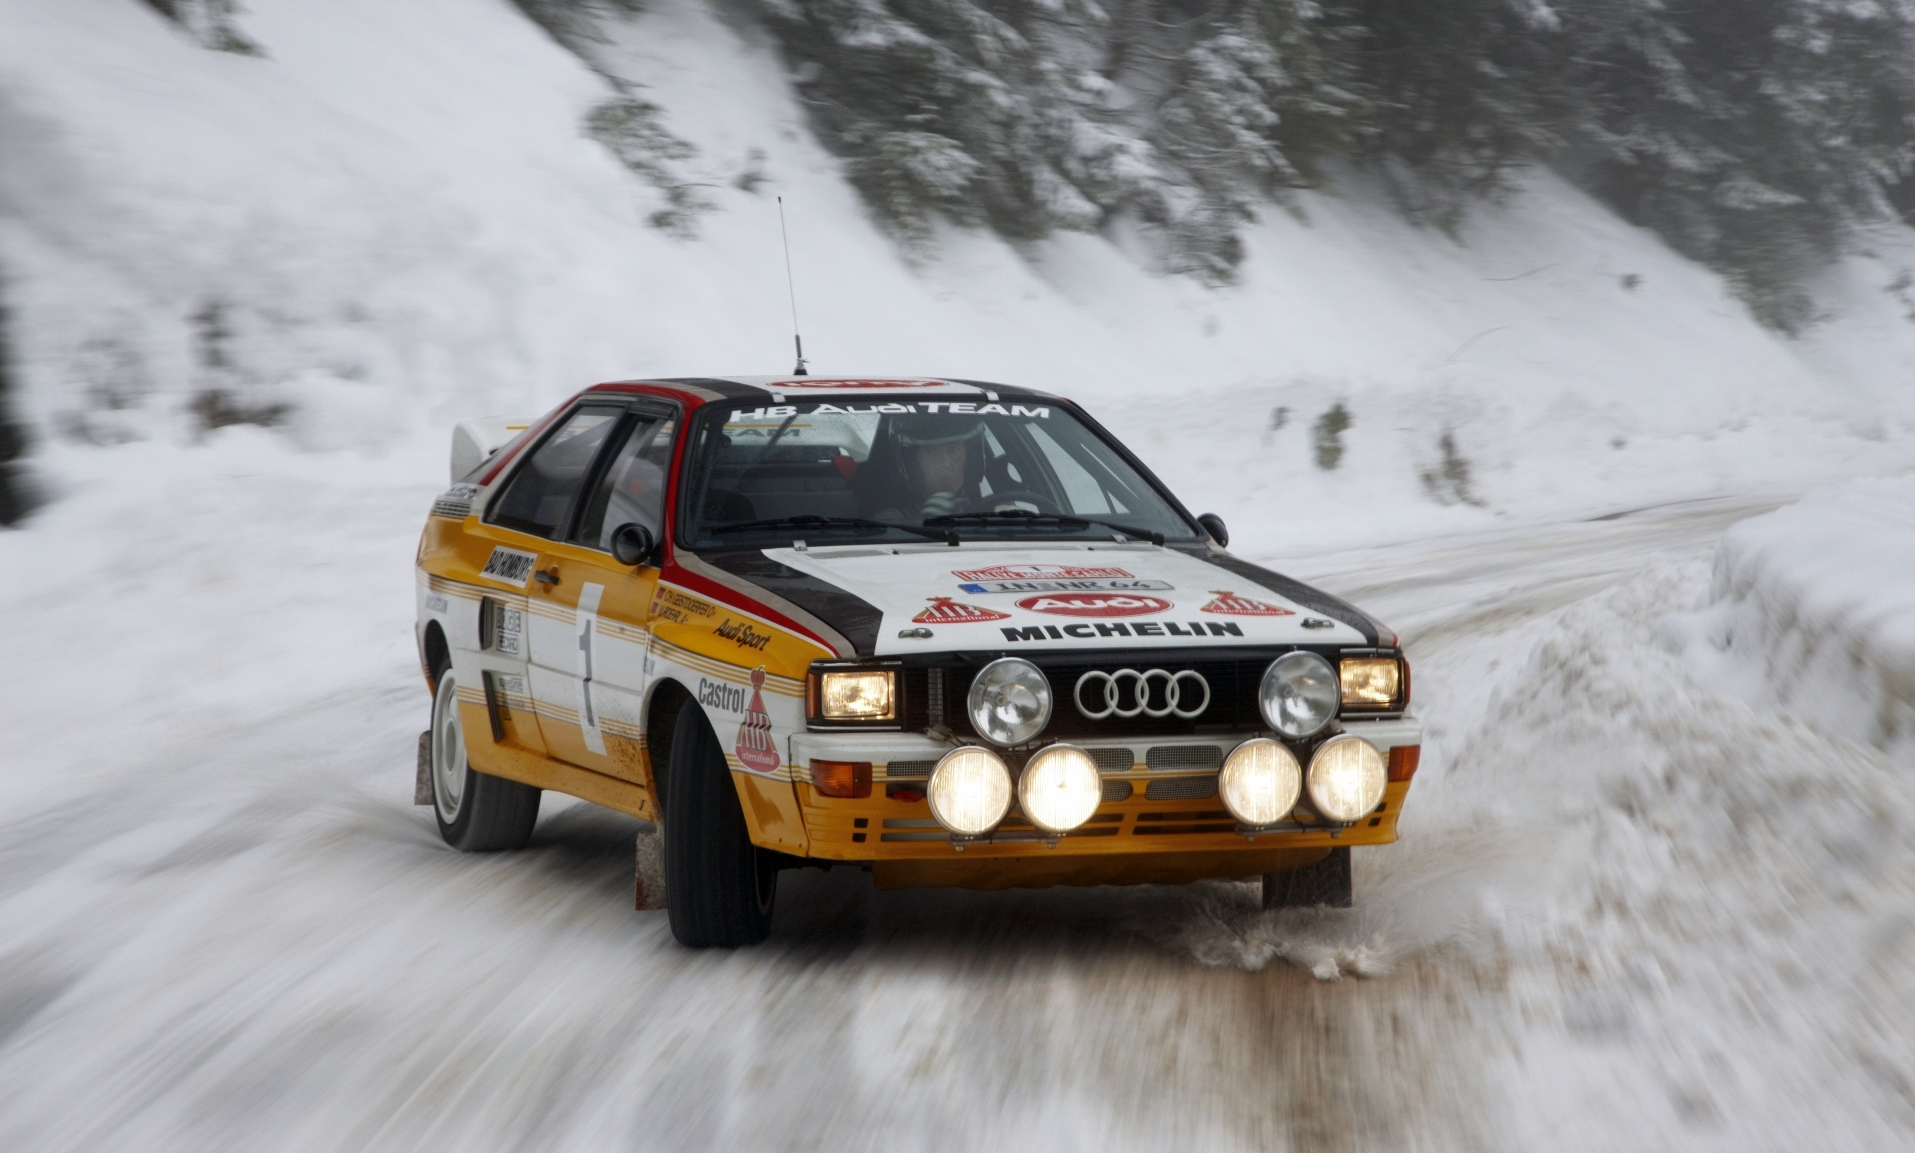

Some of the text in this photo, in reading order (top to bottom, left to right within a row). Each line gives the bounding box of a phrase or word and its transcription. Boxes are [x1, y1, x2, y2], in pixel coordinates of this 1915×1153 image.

[730, 404, 797, 422] HB
[917, 402, 1050, 419] TEAM
[721, 428, 801, 437] EAM
[1110, 580, 1151, 588] 64
[925, 614, 999, 623] international
[926, 604, 981, 619] HB
[713, 618, 771, 651] Audi Sport
[1000, 621, 1245, 642] MICHELIN
[579, 619, 595, 727] 1
[699, 677, 746, 714] Castrol
[744, 709, 770, 751] HB
[741, 750, 775, 765] international
